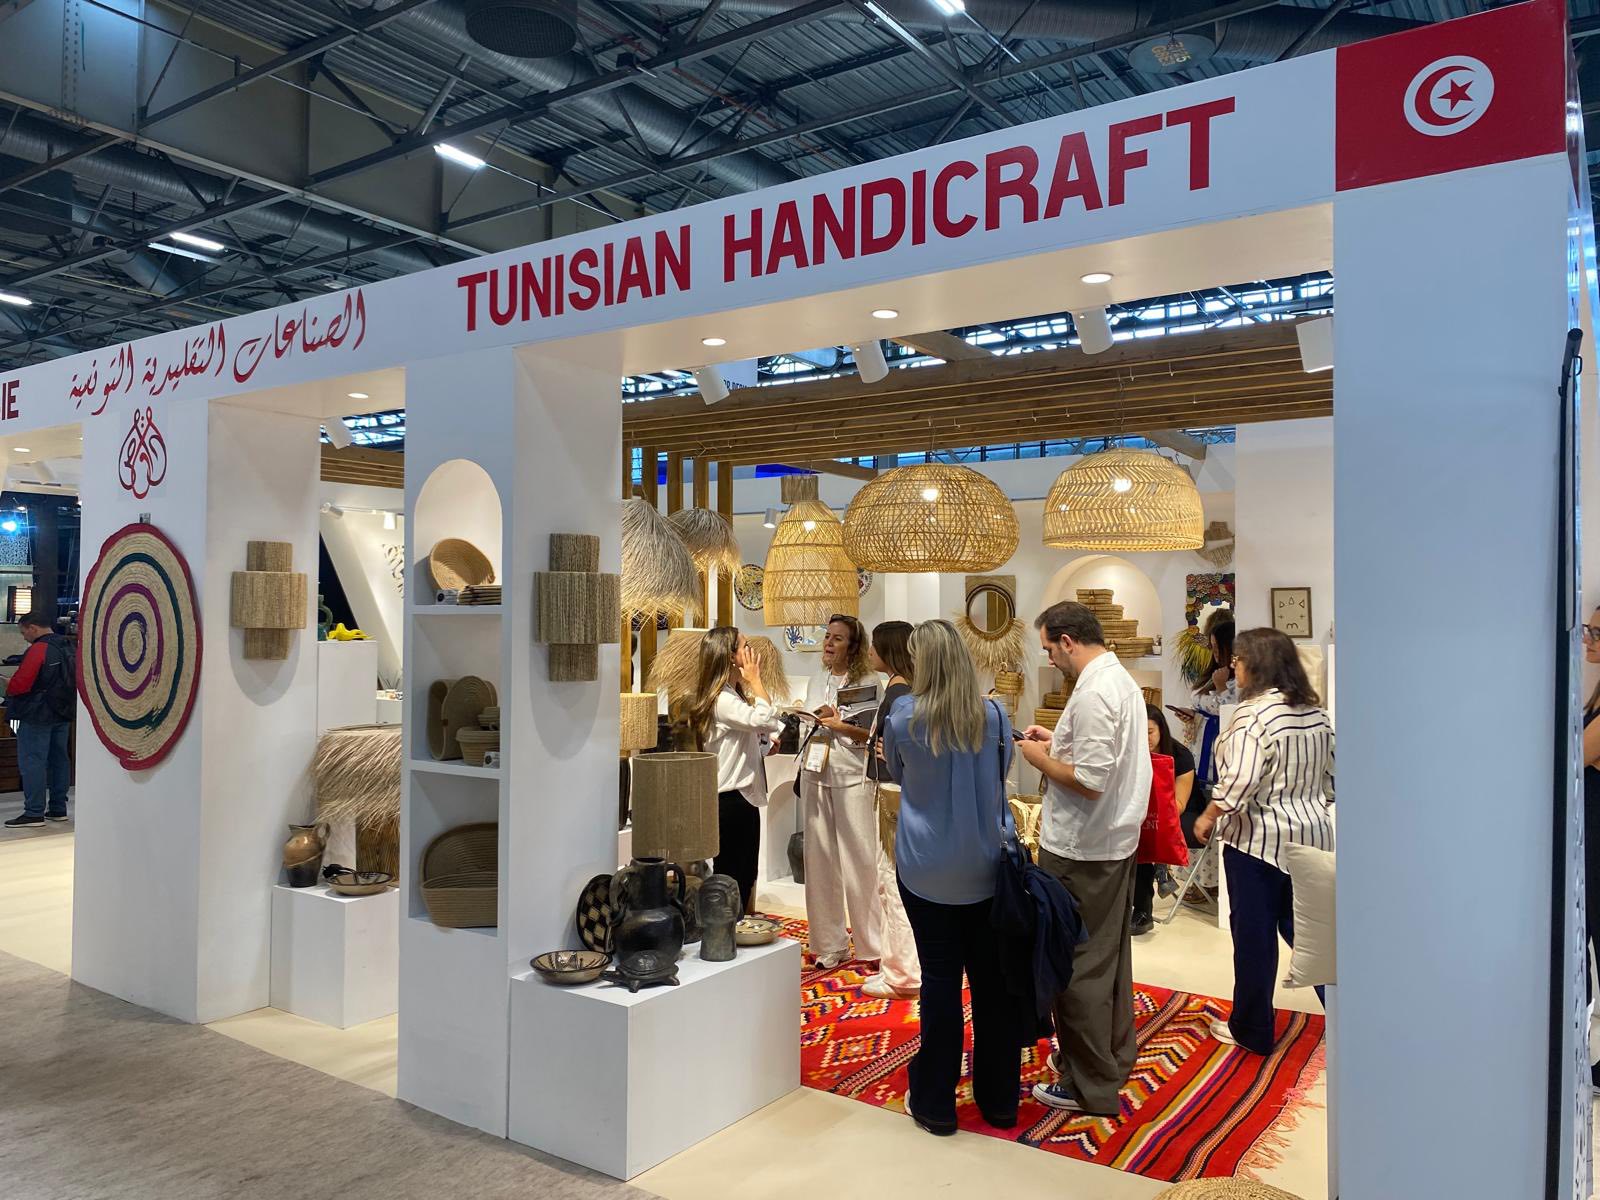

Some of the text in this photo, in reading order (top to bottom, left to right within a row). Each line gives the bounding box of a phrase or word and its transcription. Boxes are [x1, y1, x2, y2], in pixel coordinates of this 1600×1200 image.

[458, 96, 1236, 332] TUNISIAN HANDICRAFT
[69, 287, 364, 416] الصناعات التقليدية التونسية
